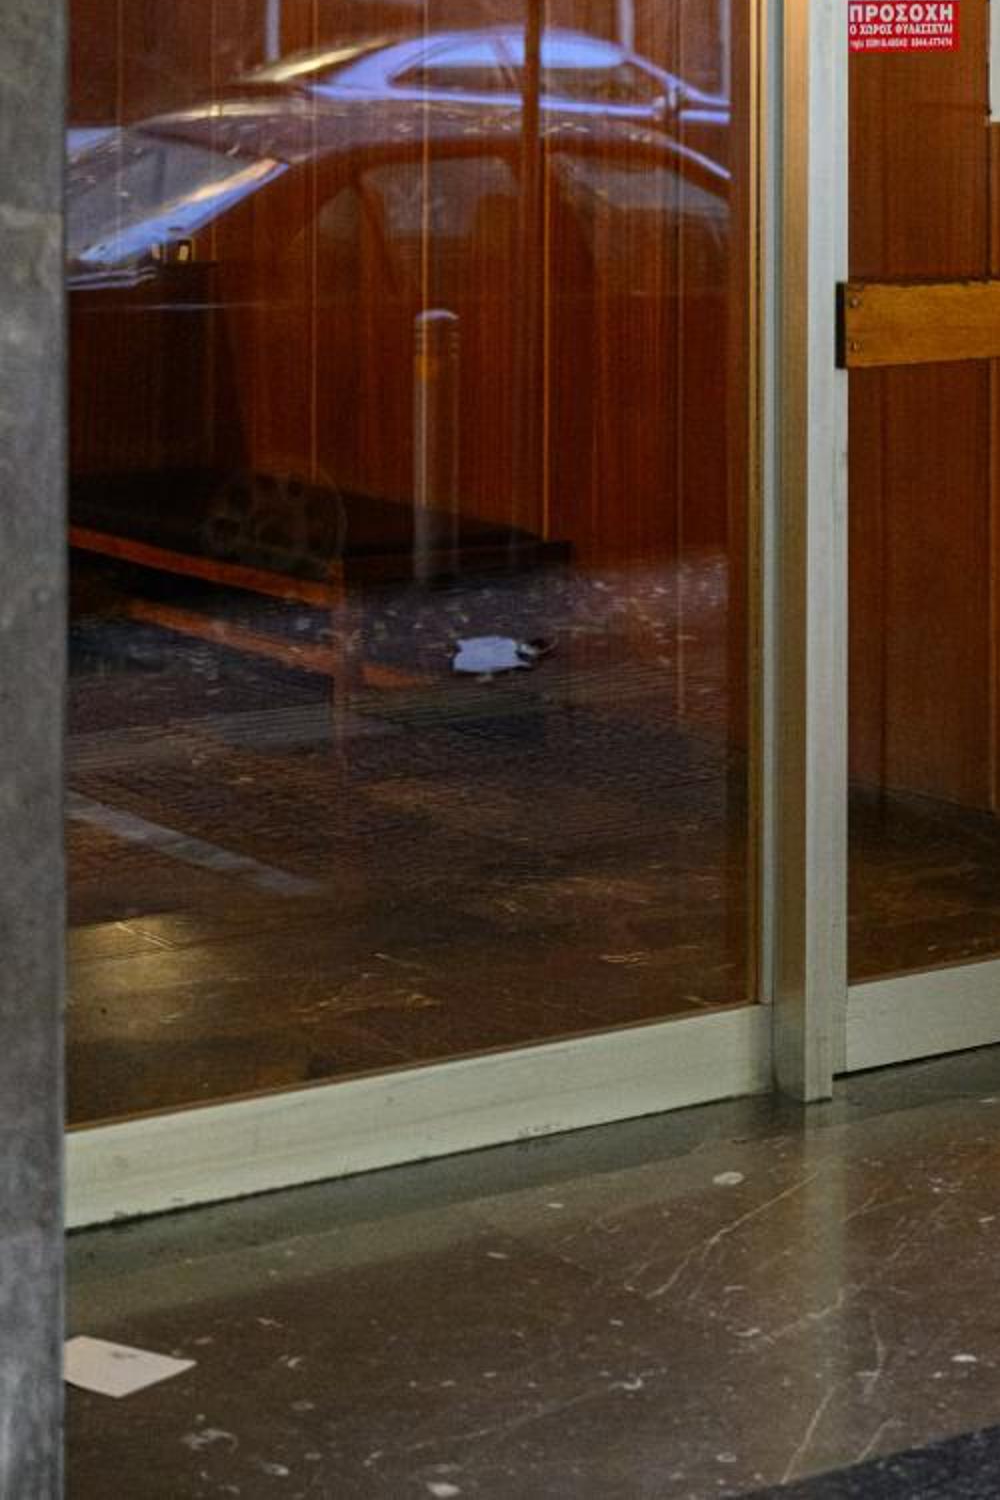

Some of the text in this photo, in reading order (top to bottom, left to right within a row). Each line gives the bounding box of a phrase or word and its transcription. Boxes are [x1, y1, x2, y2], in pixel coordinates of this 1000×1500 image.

[849, 3, 953, 23] ΠΡΟΣΟΧΗ
[849, 22, 953, 35] Ο ΧΩΡΟΣ ΦΥΛΑΣΣΕΤΑΙ
